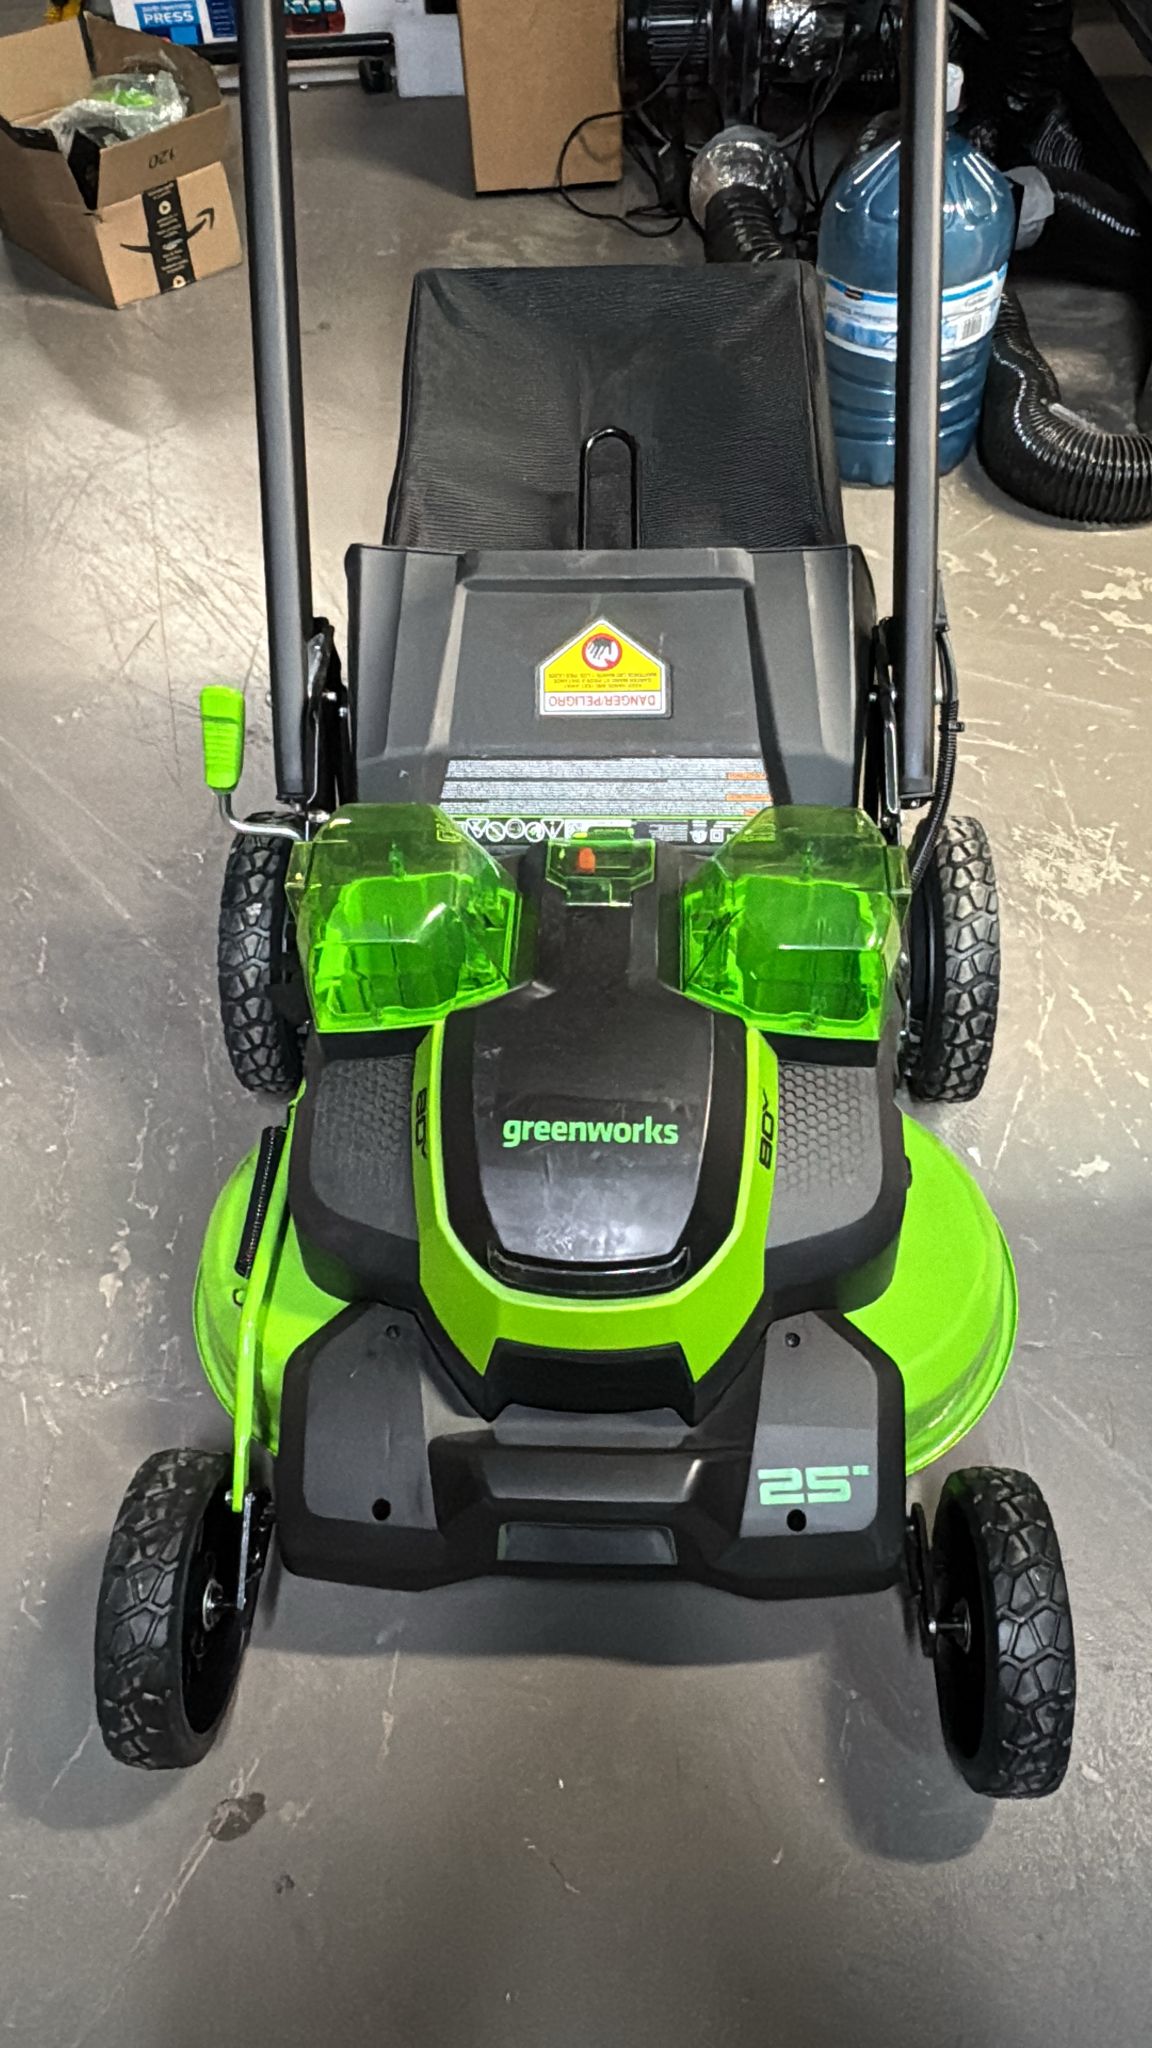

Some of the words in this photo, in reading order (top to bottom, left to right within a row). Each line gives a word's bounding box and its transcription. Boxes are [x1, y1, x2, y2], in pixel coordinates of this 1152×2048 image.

[143, 10, 195, 25] PRESS
[502, 1116, 679, 1148] greenworks
[759, 1088, 774, 1170] 80V
[757, 1465, 870, 1505] 25"
